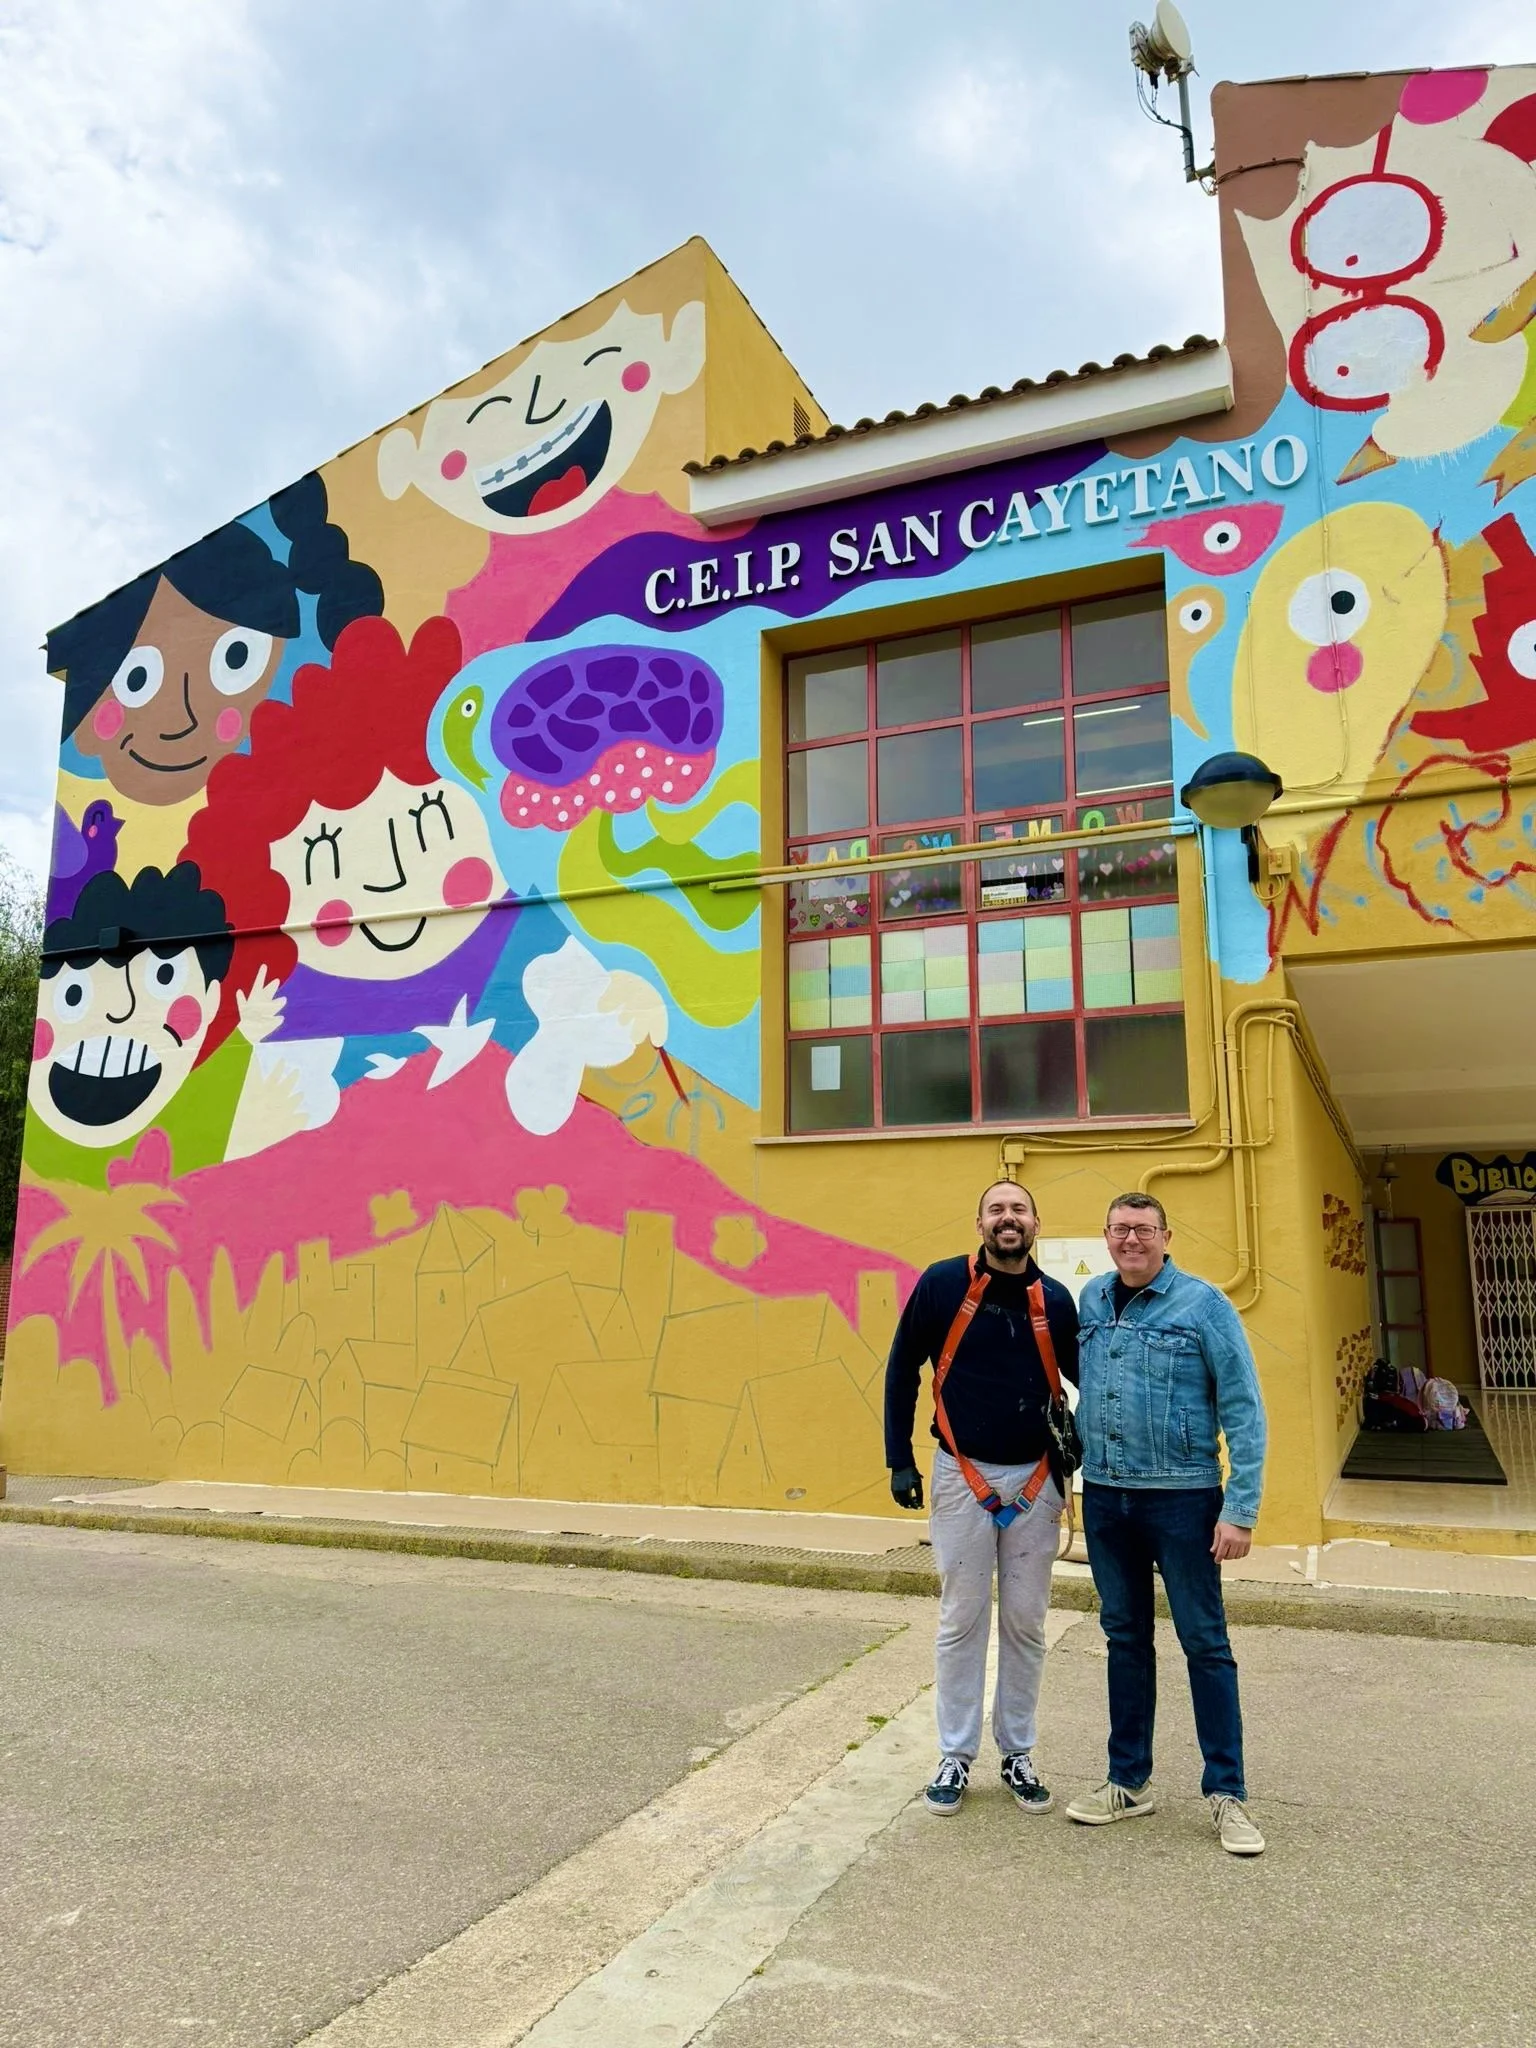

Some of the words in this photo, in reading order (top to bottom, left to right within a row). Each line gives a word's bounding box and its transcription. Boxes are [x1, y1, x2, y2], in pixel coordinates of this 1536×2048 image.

[645, 542, 800, 614] C.E.I.P.
[829, 510, 941, 578] SAN
[959, 434, 1308, 549] CAYETANO
